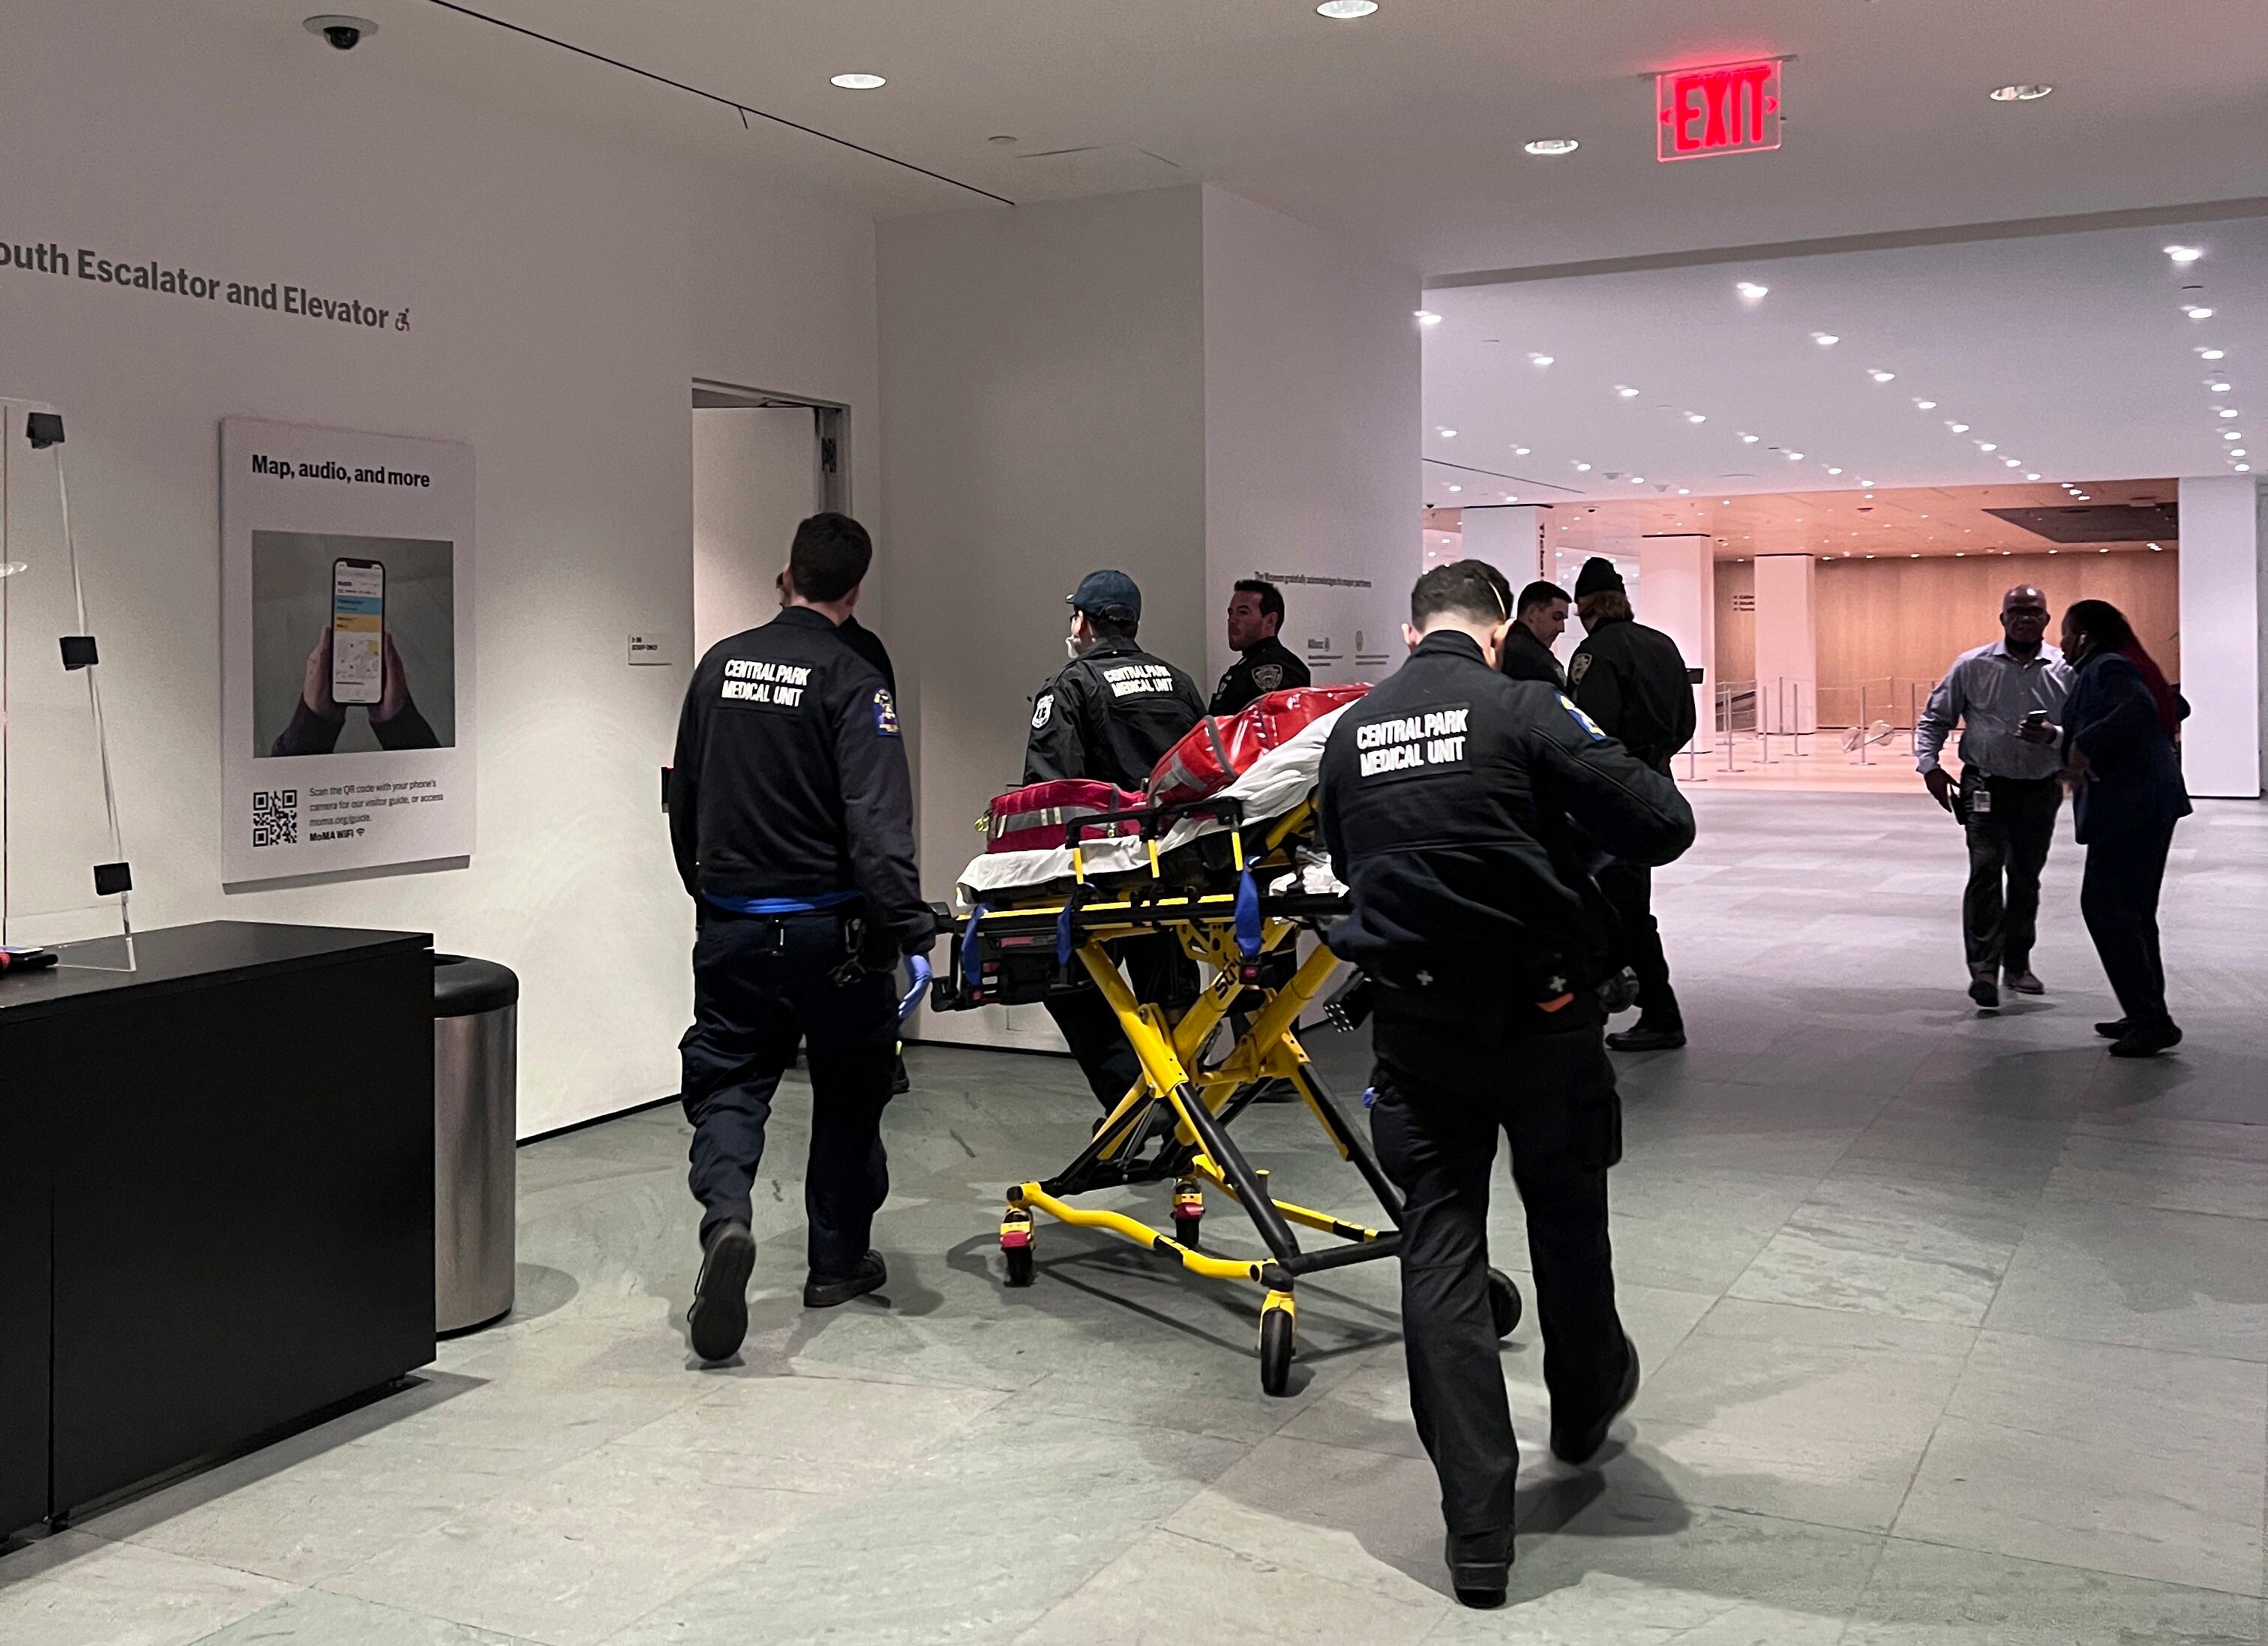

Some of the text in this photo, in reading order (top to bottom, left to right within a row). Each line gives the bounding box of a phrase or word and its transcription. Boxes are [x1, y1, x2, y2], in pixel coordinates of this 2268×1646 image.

[1675, 64, 1772, 151] EXIT
[78, 248, 220, 300] Escalator
[226, 283, 278, 310] and
[284, 286, 388, 328] Elevator
[252, 454, 430, 487] Map, audio, and more
[724, 659, 812, 685] CENTRAL PARK
[722, 680, 804, 707] MEDICAL UNIT
[1112, 679, 1155, 697] MEDICAL
[1357, 709, 1469, 750] CENTRAL PARK
[1360, 736, 1466, 777] MEDICAL UNIT
[309, 787, 328, 796] Scan
[330, 787, 342, 796] the
[344, 785, 355, 796] QR
[356, 784, 374, 793] code
[392, 782, 407, 793] your
[339, 801, 350, 809] for
[351, 800, 364, 808] our
[309, 831, 336, 841] MoMA
